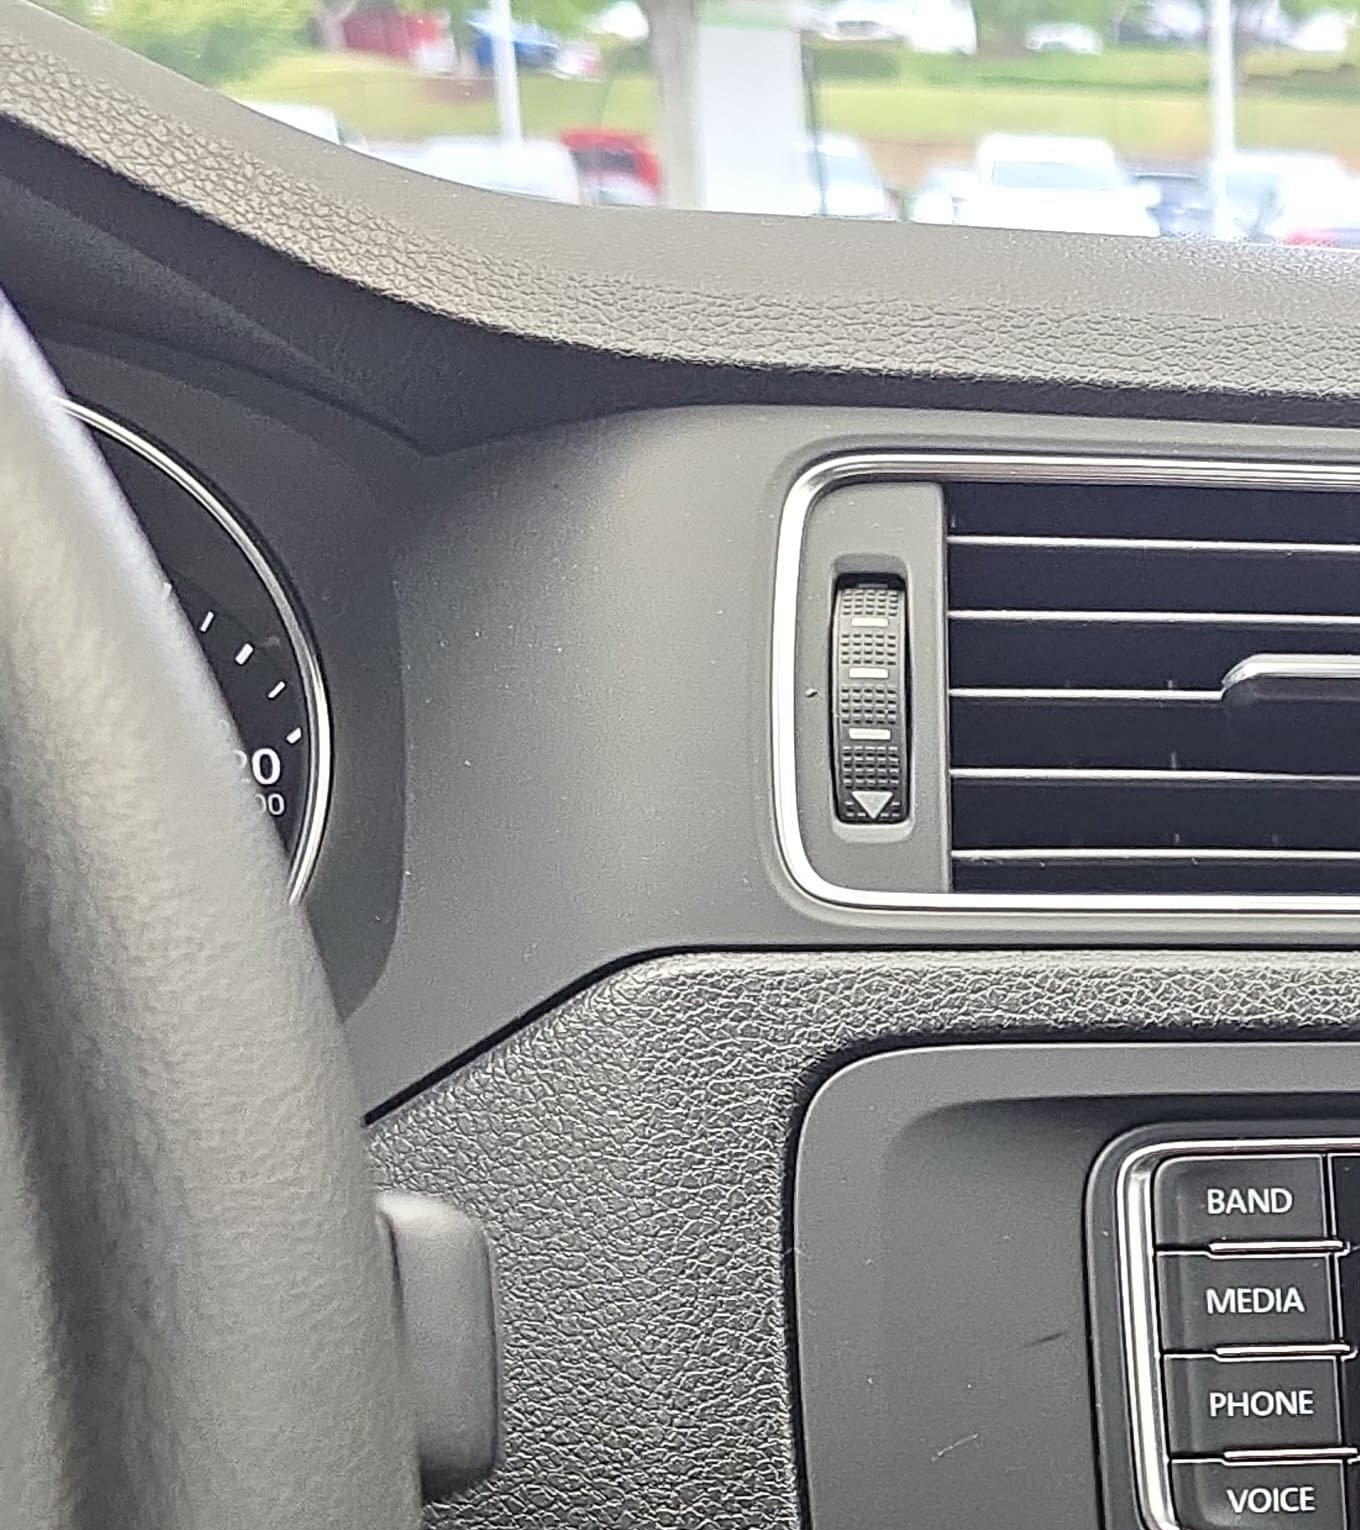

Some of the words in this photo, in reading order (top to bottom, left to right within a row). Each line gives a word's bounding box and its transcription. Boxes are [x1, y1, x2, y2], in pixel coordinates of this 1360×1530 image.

[1207, 1188, 1293, 1215] BAND
[1206, 1286, 1305, 1314] MEDIA
[1209, 1389, 1315, 1417] PHONE
[1226, 1486, 1316, 1514] VOICE
